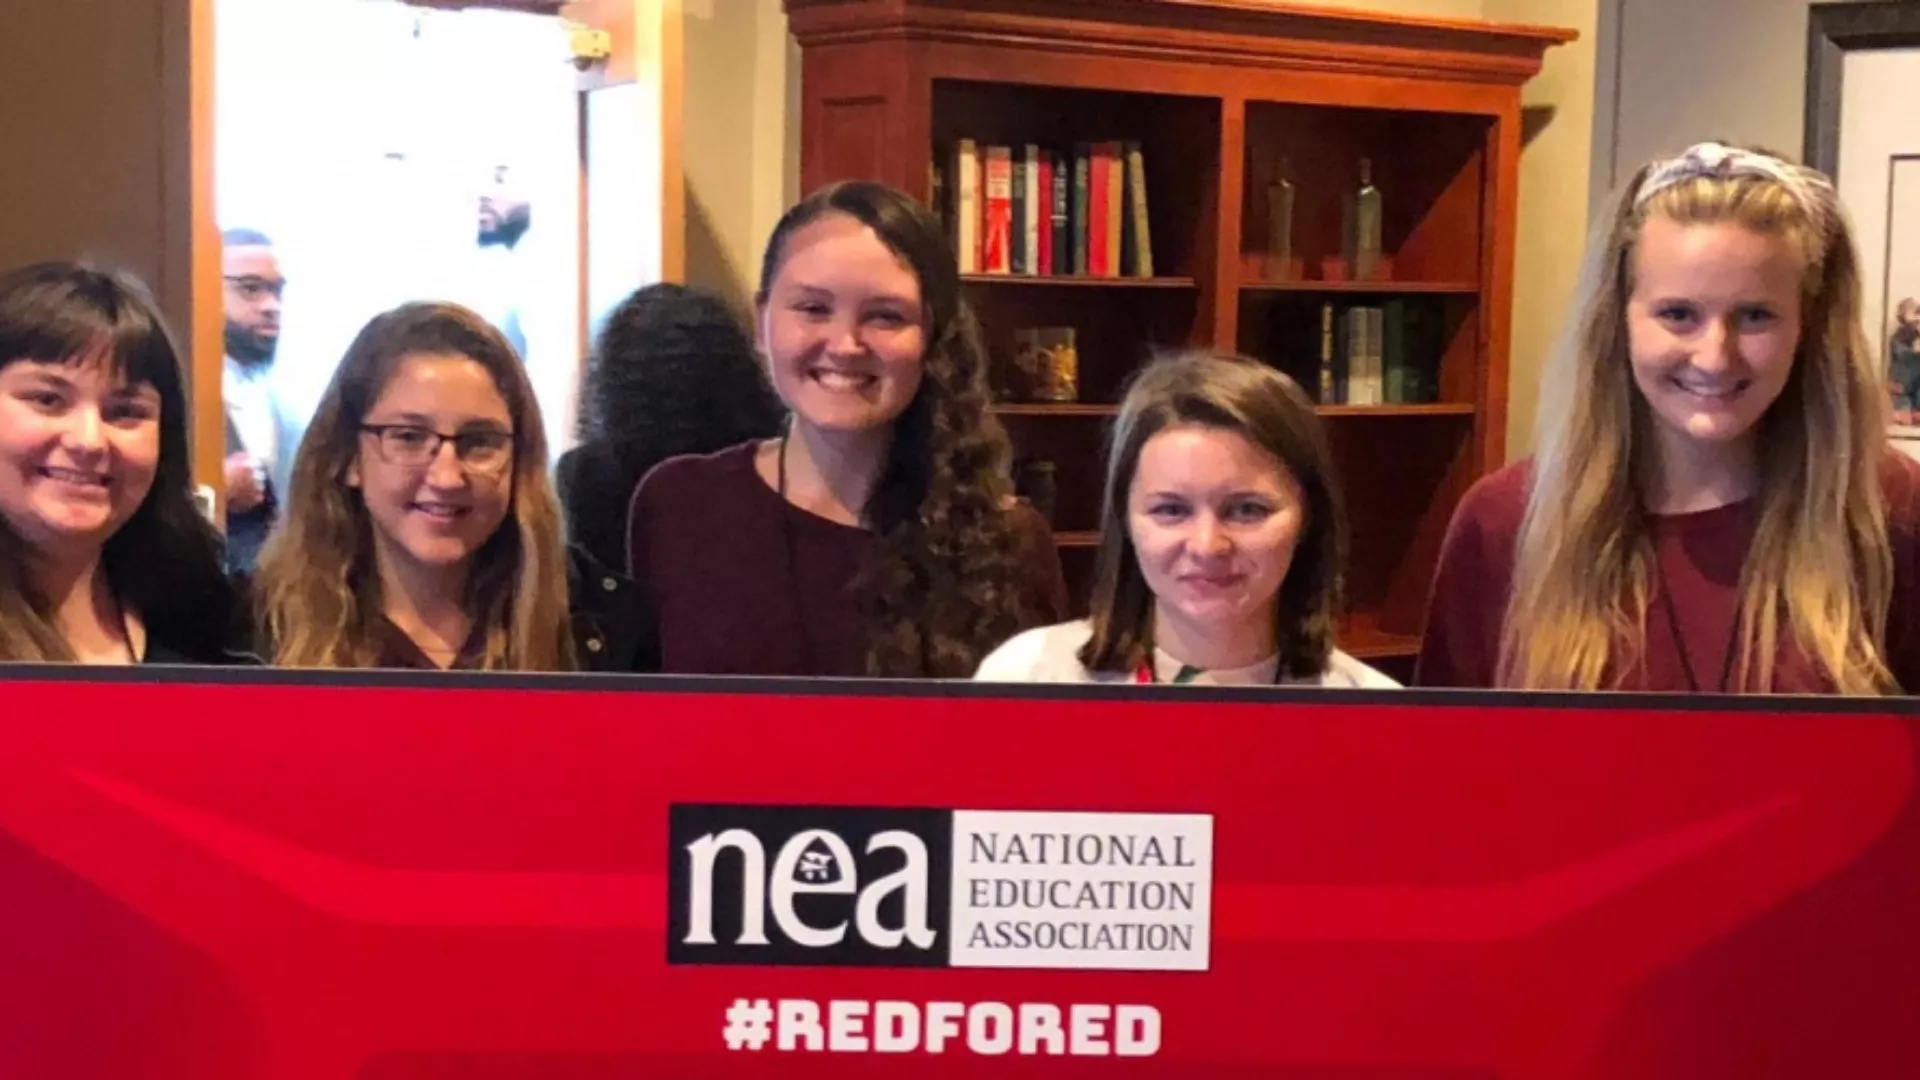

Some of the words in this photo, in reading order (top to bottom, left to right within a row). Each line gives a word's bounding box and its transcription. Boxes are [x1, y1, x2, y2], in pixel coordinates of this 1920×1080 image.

[969, 833, 1196, 867] NATIONAL
[682, 829, 937, 950] nea
[969, 879, 1195, 911] EDUCATION
[966, 922, 1193, 951] ASSOCIATION
[723, 998, 1162, 1056] #REDFORED
